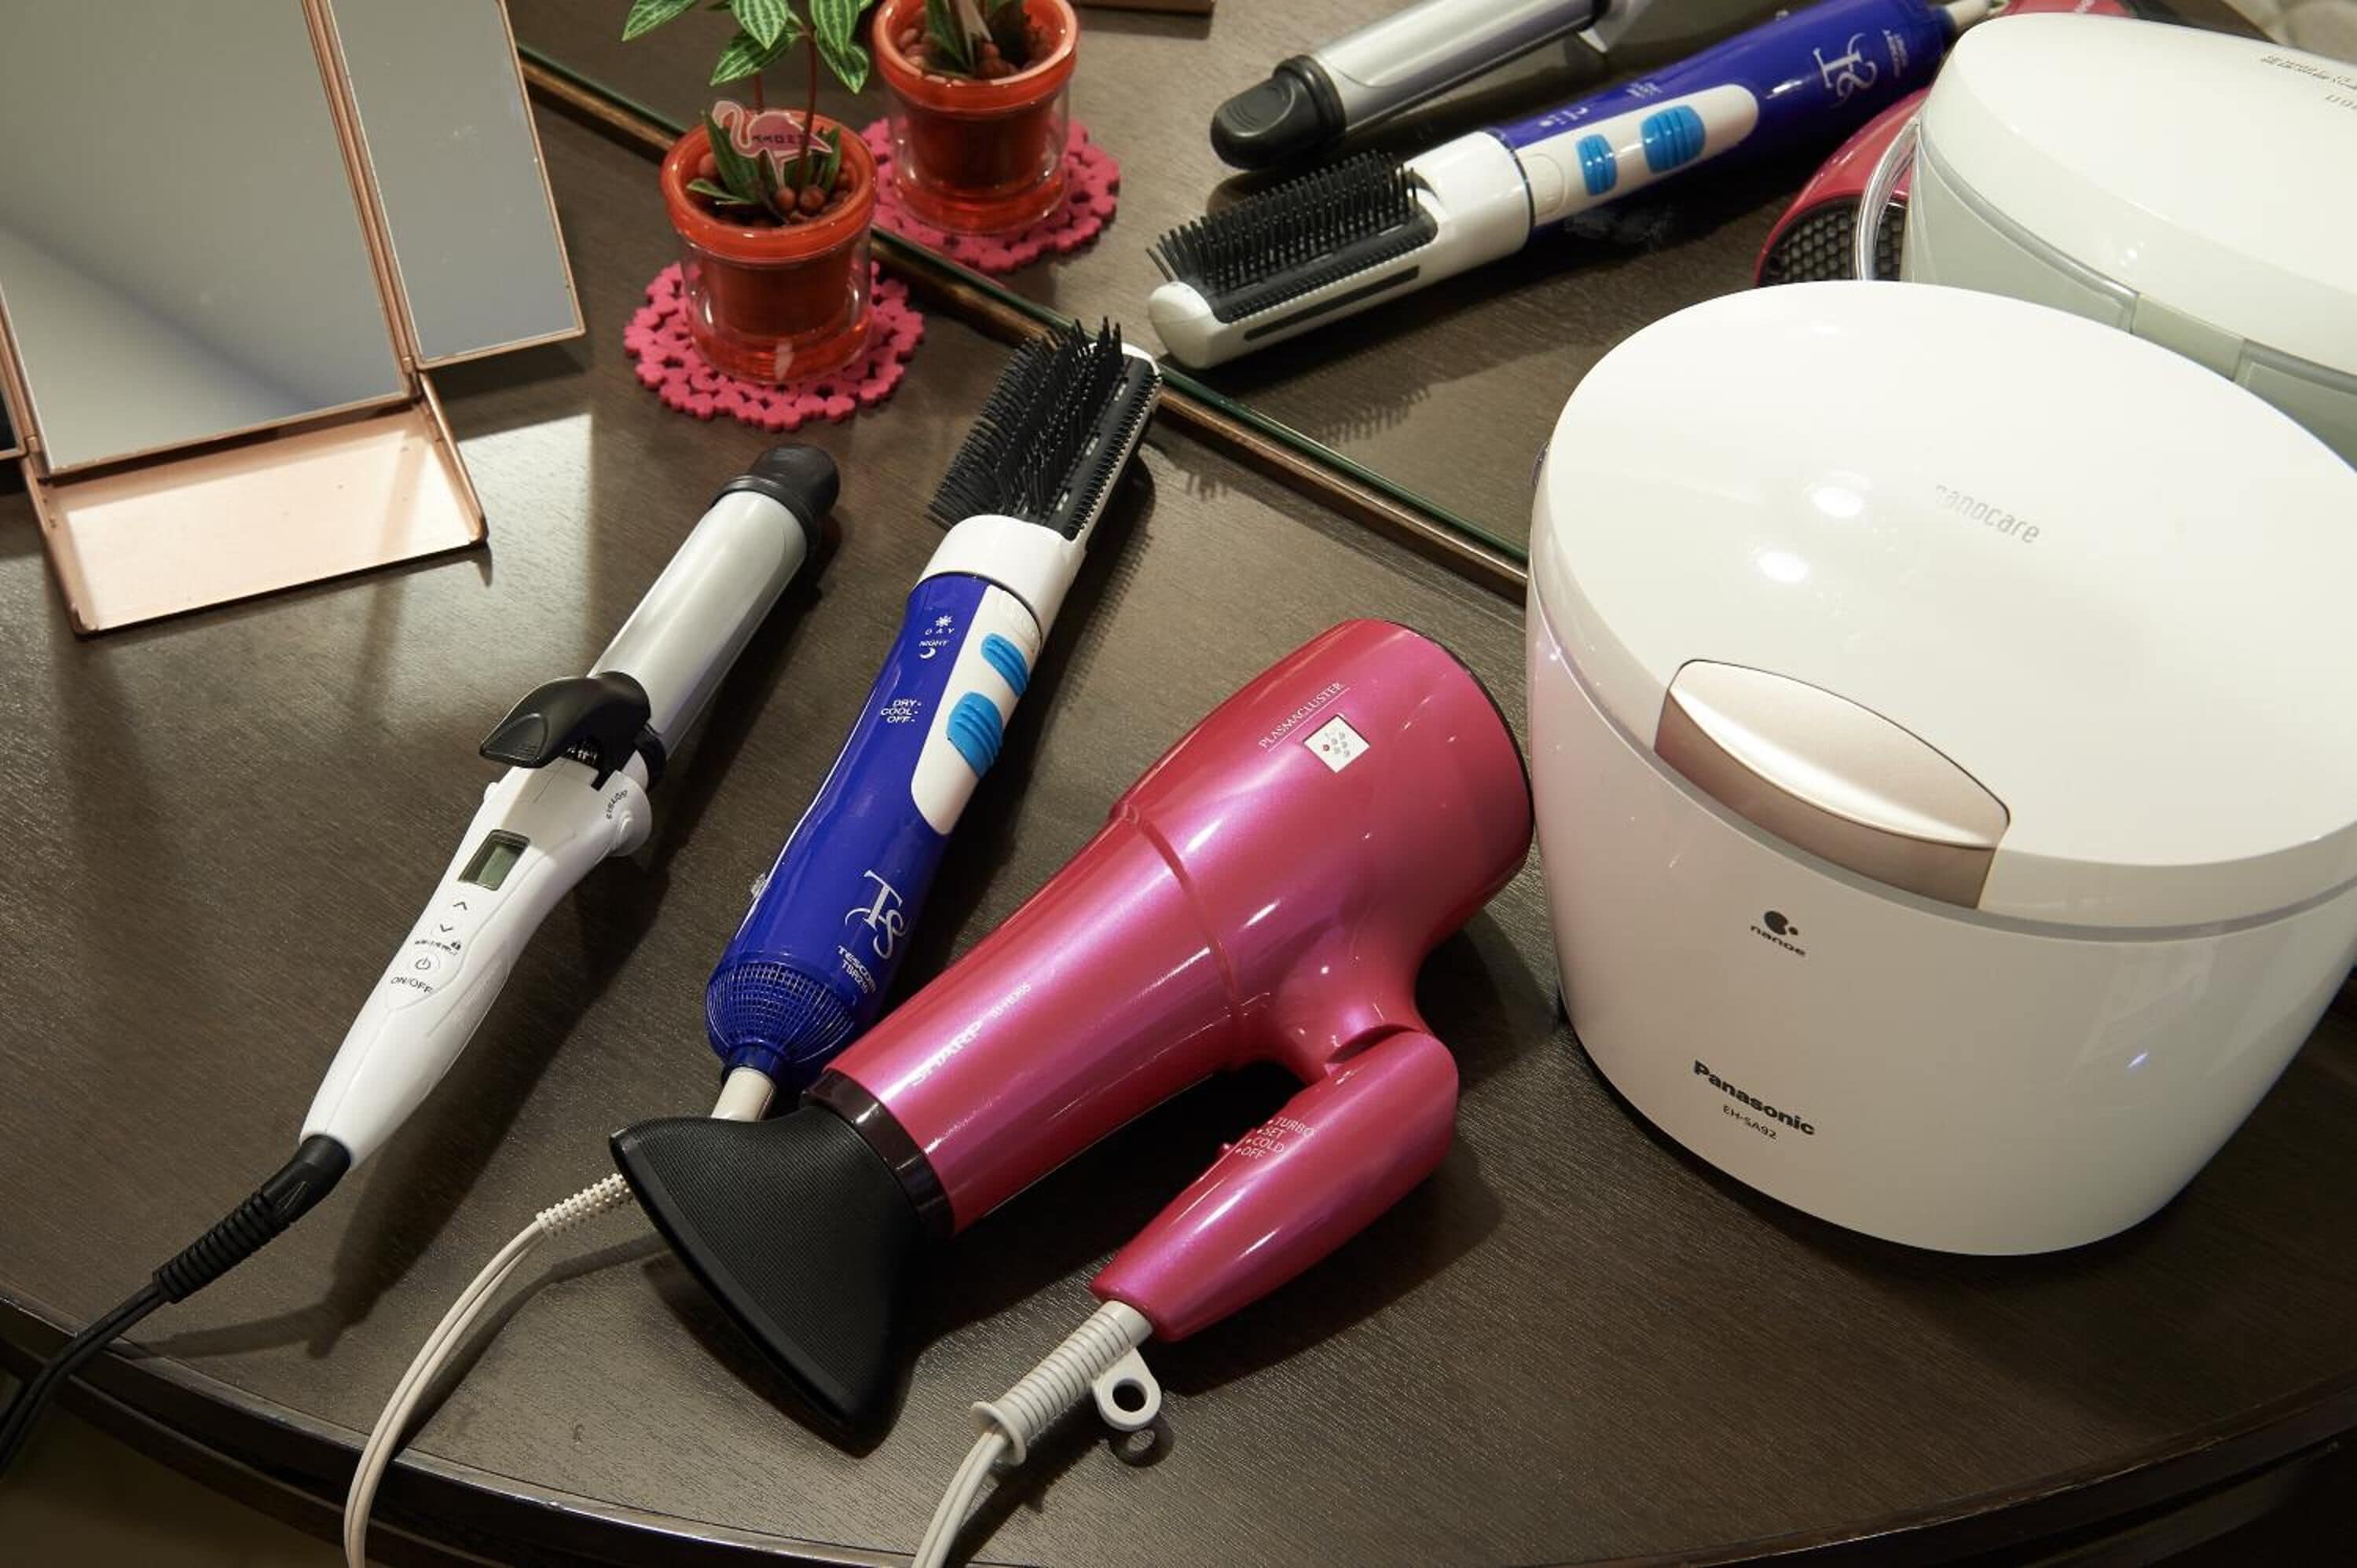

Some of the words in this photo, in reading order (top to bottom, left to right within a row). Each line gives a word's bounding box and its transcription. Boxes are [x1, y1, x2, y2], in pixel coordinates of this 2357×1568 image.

[1935, 484, 2040, 544] nanocare
[1258, 682, 1343, 749] PLASMACLUSTER
[1750, 924, 1806, 958] nanoe
[390, 976, 434, 993] ON/OFF
[1693, 1059, 1816, 1136] Panasonic
[1275, 1116, 1314, 1138] TURBO
[1723, 1104, 1778, 1140] EH-SA92
[1241, 1146, 1266, 1159] OFF
[1252, 1136, 1285, 1152] COLD
